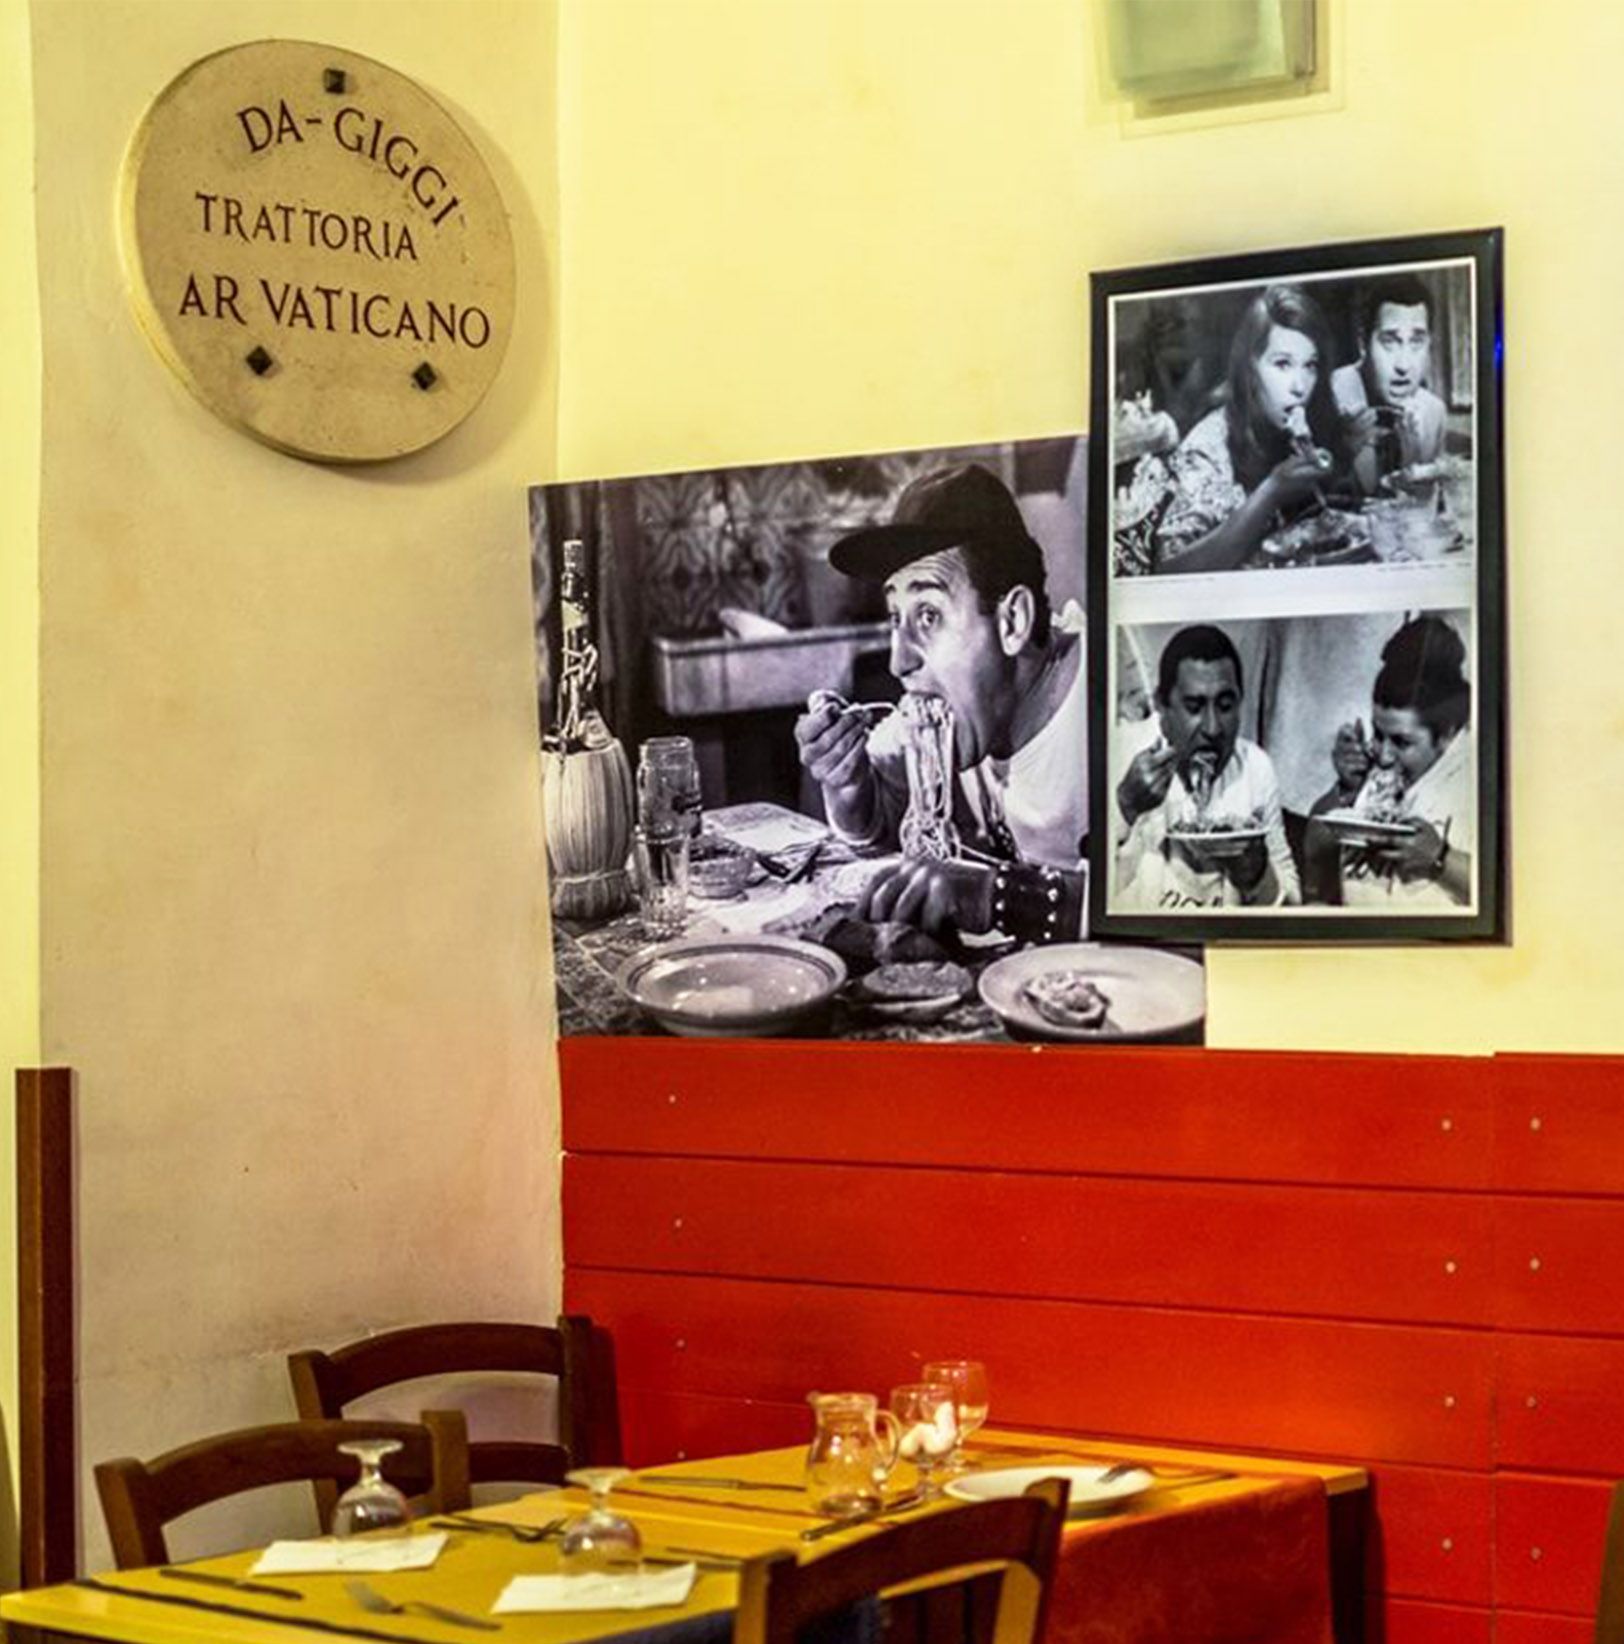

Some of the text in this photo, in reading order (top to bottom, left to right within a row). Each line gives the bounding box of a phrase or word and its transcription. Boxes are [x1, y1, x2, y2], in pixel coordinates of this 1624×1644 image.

[236, 98, 460, 229] DA-GIGGI
[194, 191, 420, 261] TRATTORIA
[178, 272, 491, 350] AR VATICANO
